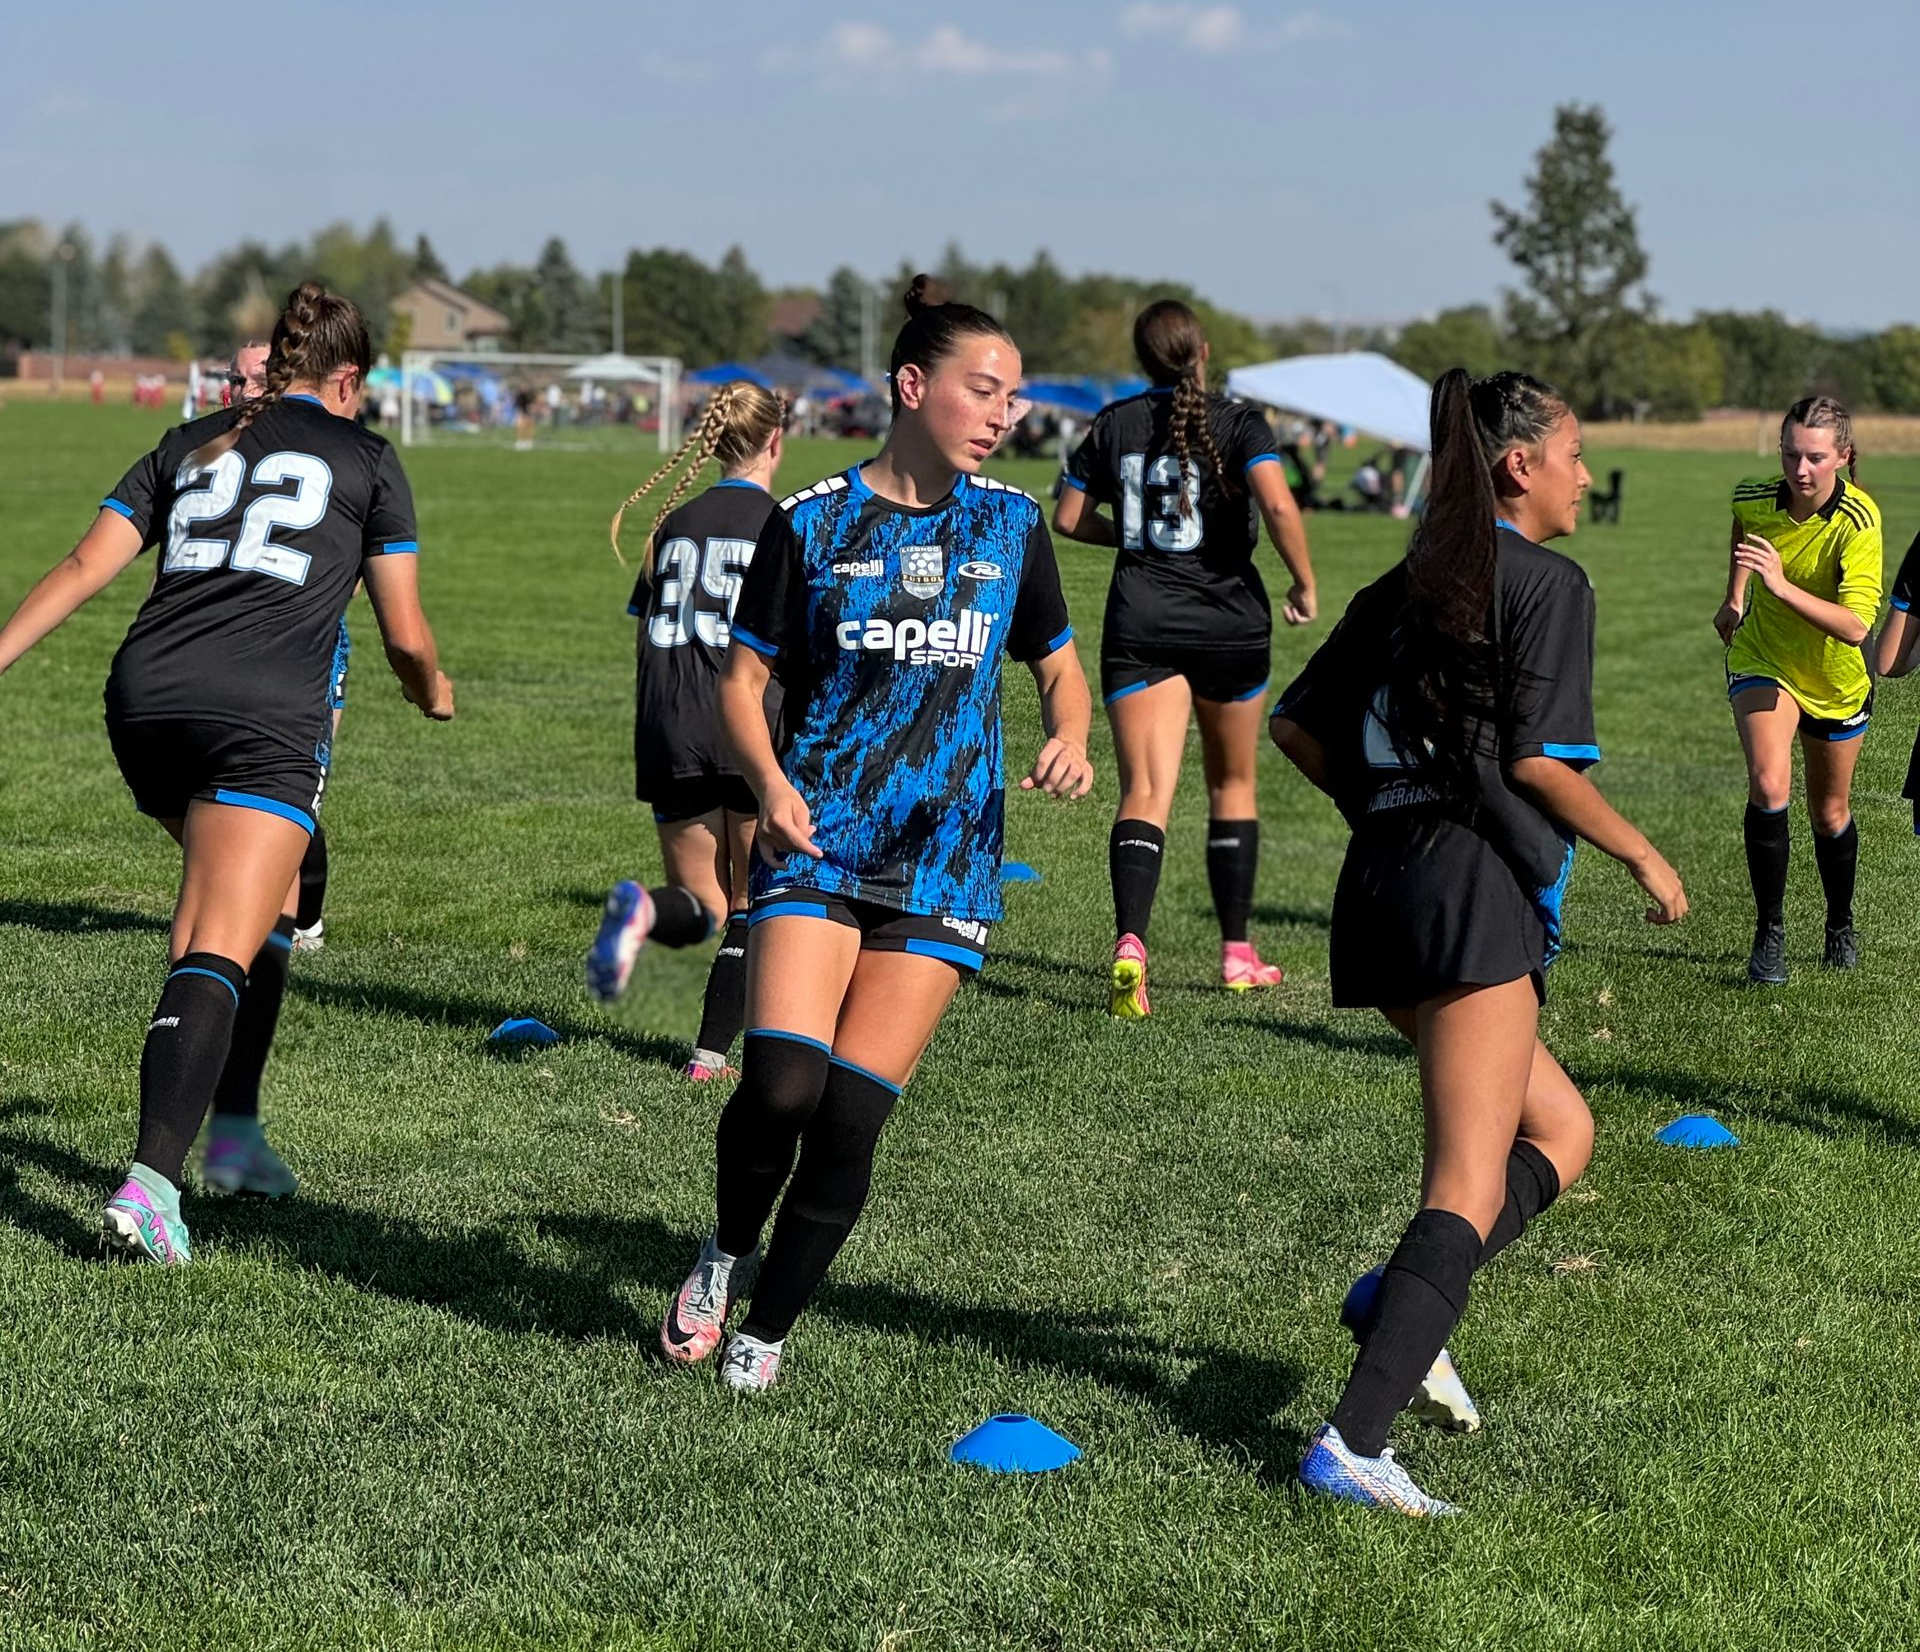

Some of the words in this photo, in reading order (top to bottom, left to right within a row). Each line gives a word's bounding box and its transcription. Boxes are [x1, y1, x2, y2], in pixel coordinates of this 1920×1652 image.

[163, 448, 333, 586] 22
[1120, 453, 1203, 551] 13
[648, 537, 757, 648] 35
[833, 559, 884, 576] capelli
[903, 574, 944, 582] FUTBOL
[836, 608, 992, 661] capelli
[942, 917, 979, 934] capelli
